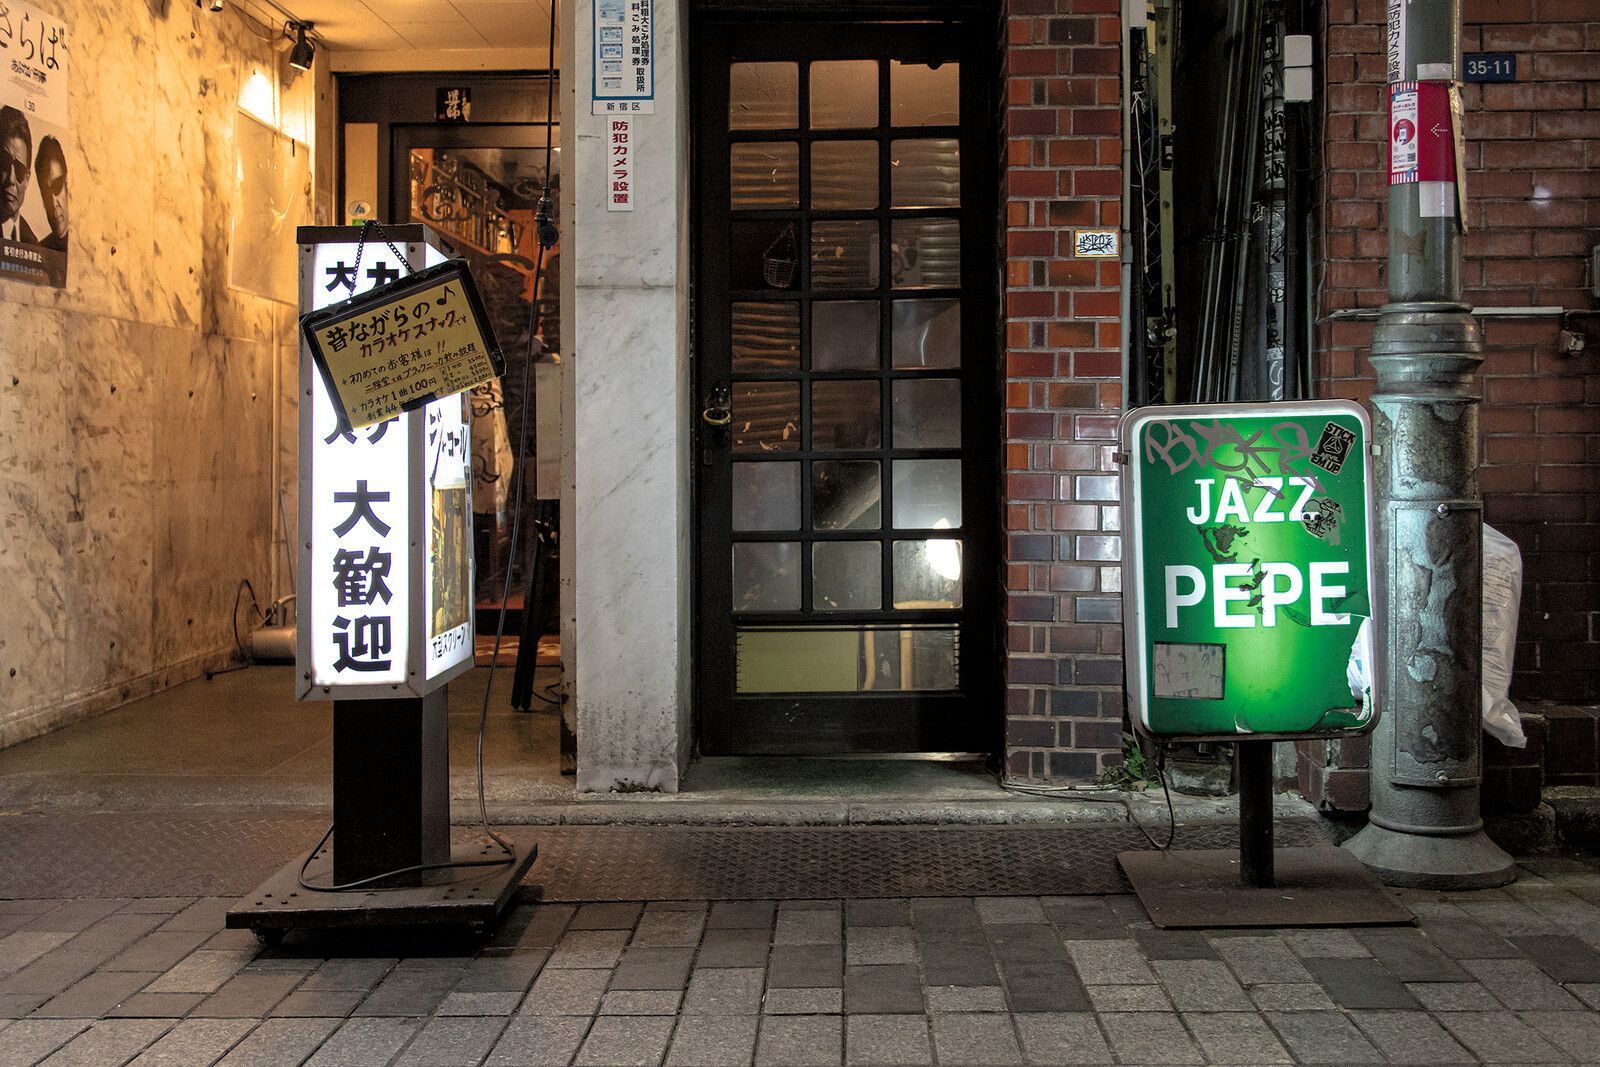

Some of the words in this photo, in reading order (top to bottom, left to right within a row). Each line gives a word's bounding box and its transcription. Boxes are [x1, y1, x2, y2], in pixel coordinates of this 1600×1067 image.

[636, 67, 645, 92] 取扱所
[1468, 60, 1510, 75] 35-11
[606, 102, 641, 111] 新宿区
[612, 121, 629, 204] 防犯カメラ設置
[326, 302, 430, 352] 昔ながらの
[1186, 476, 1317, 525] JAZZ
[332, 480, 393, 673] 大歓迎
[1164, 561, 1351, 628] PEPE
